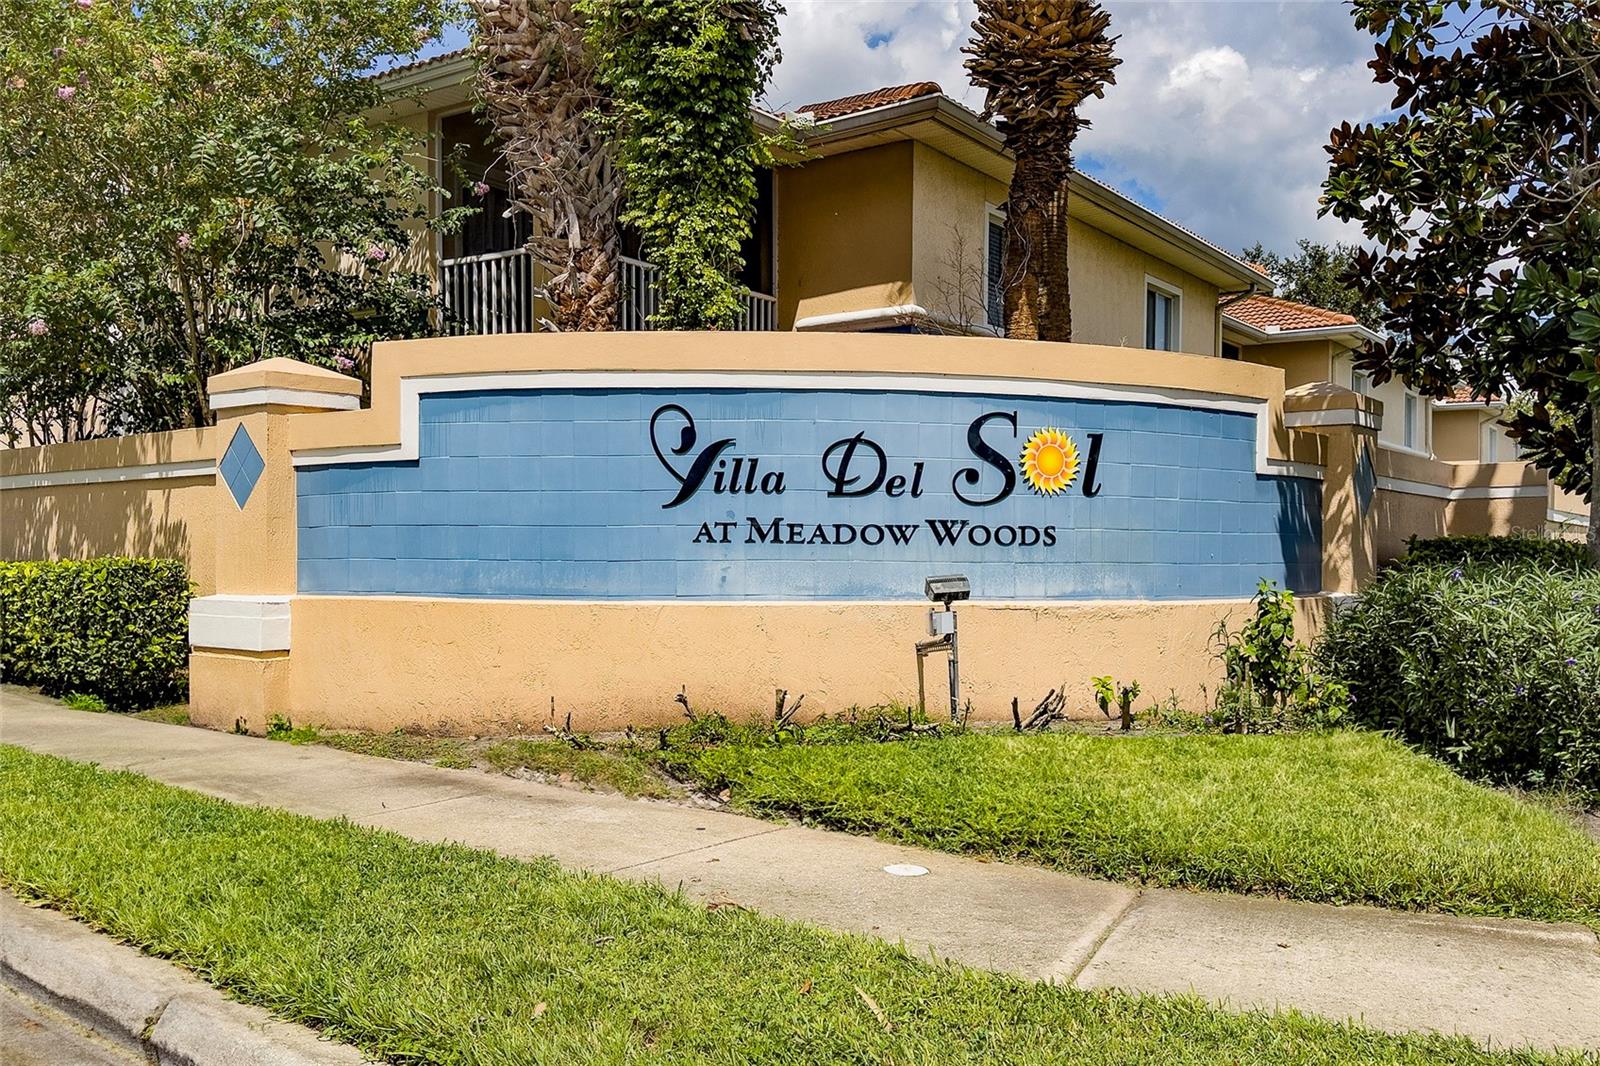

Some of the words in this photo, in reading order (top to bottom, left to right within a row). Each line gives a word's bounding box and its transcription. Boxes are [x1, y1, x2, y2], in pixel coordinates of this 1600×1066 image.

[650, 404, 786, 509] Villa
[822, 431, 923, 499] Del
[692, 523, 737, 544] AT
[744, 517, 919, 547] MEADOW
[924, 519, 1057, 547] WOODS
